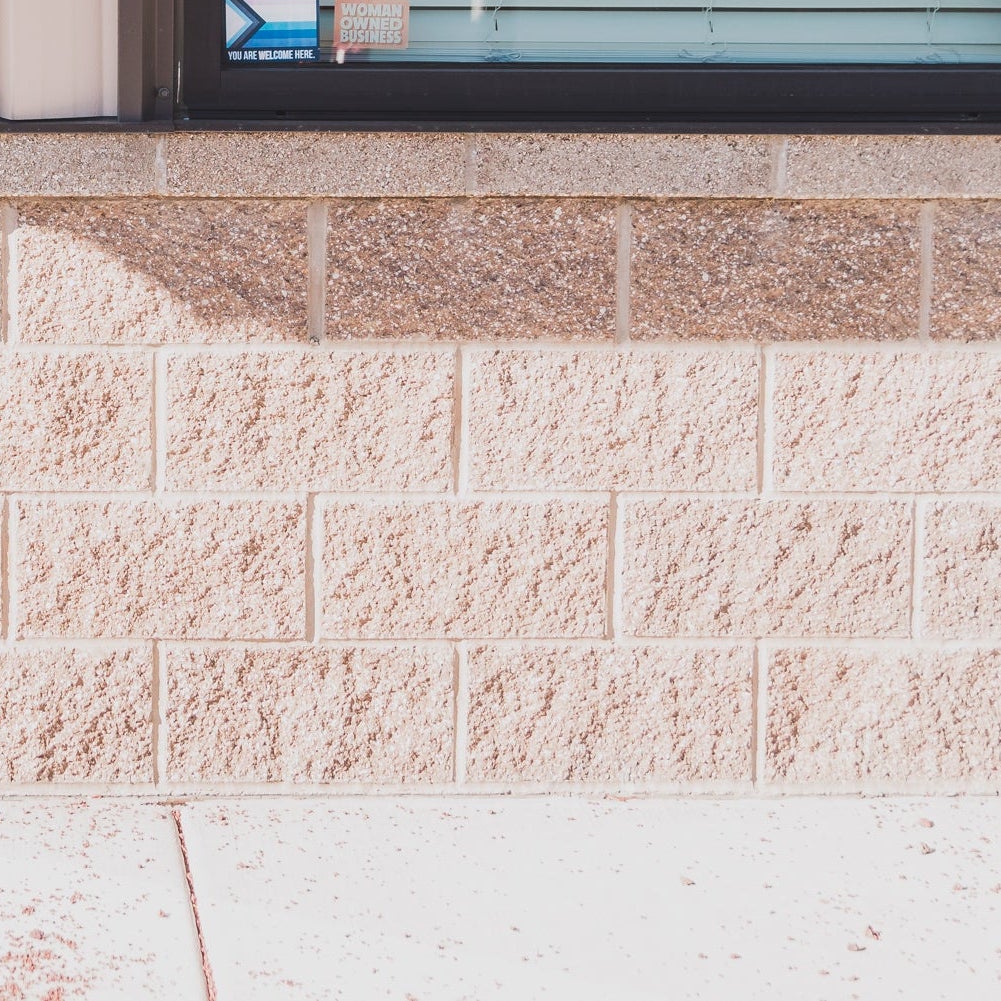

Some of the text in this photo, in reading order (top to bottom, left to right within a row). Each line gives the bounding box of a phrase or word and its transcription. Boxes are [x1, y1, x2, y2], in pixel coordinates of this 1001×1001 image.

[341, 3, 402, 17] WOMAN
[340, 17, 403, 31] OWNED
[340, 31, 402, 43] BUSINESS
[228, 50, 316, 60] YOU ARE WELCOME HERE.
